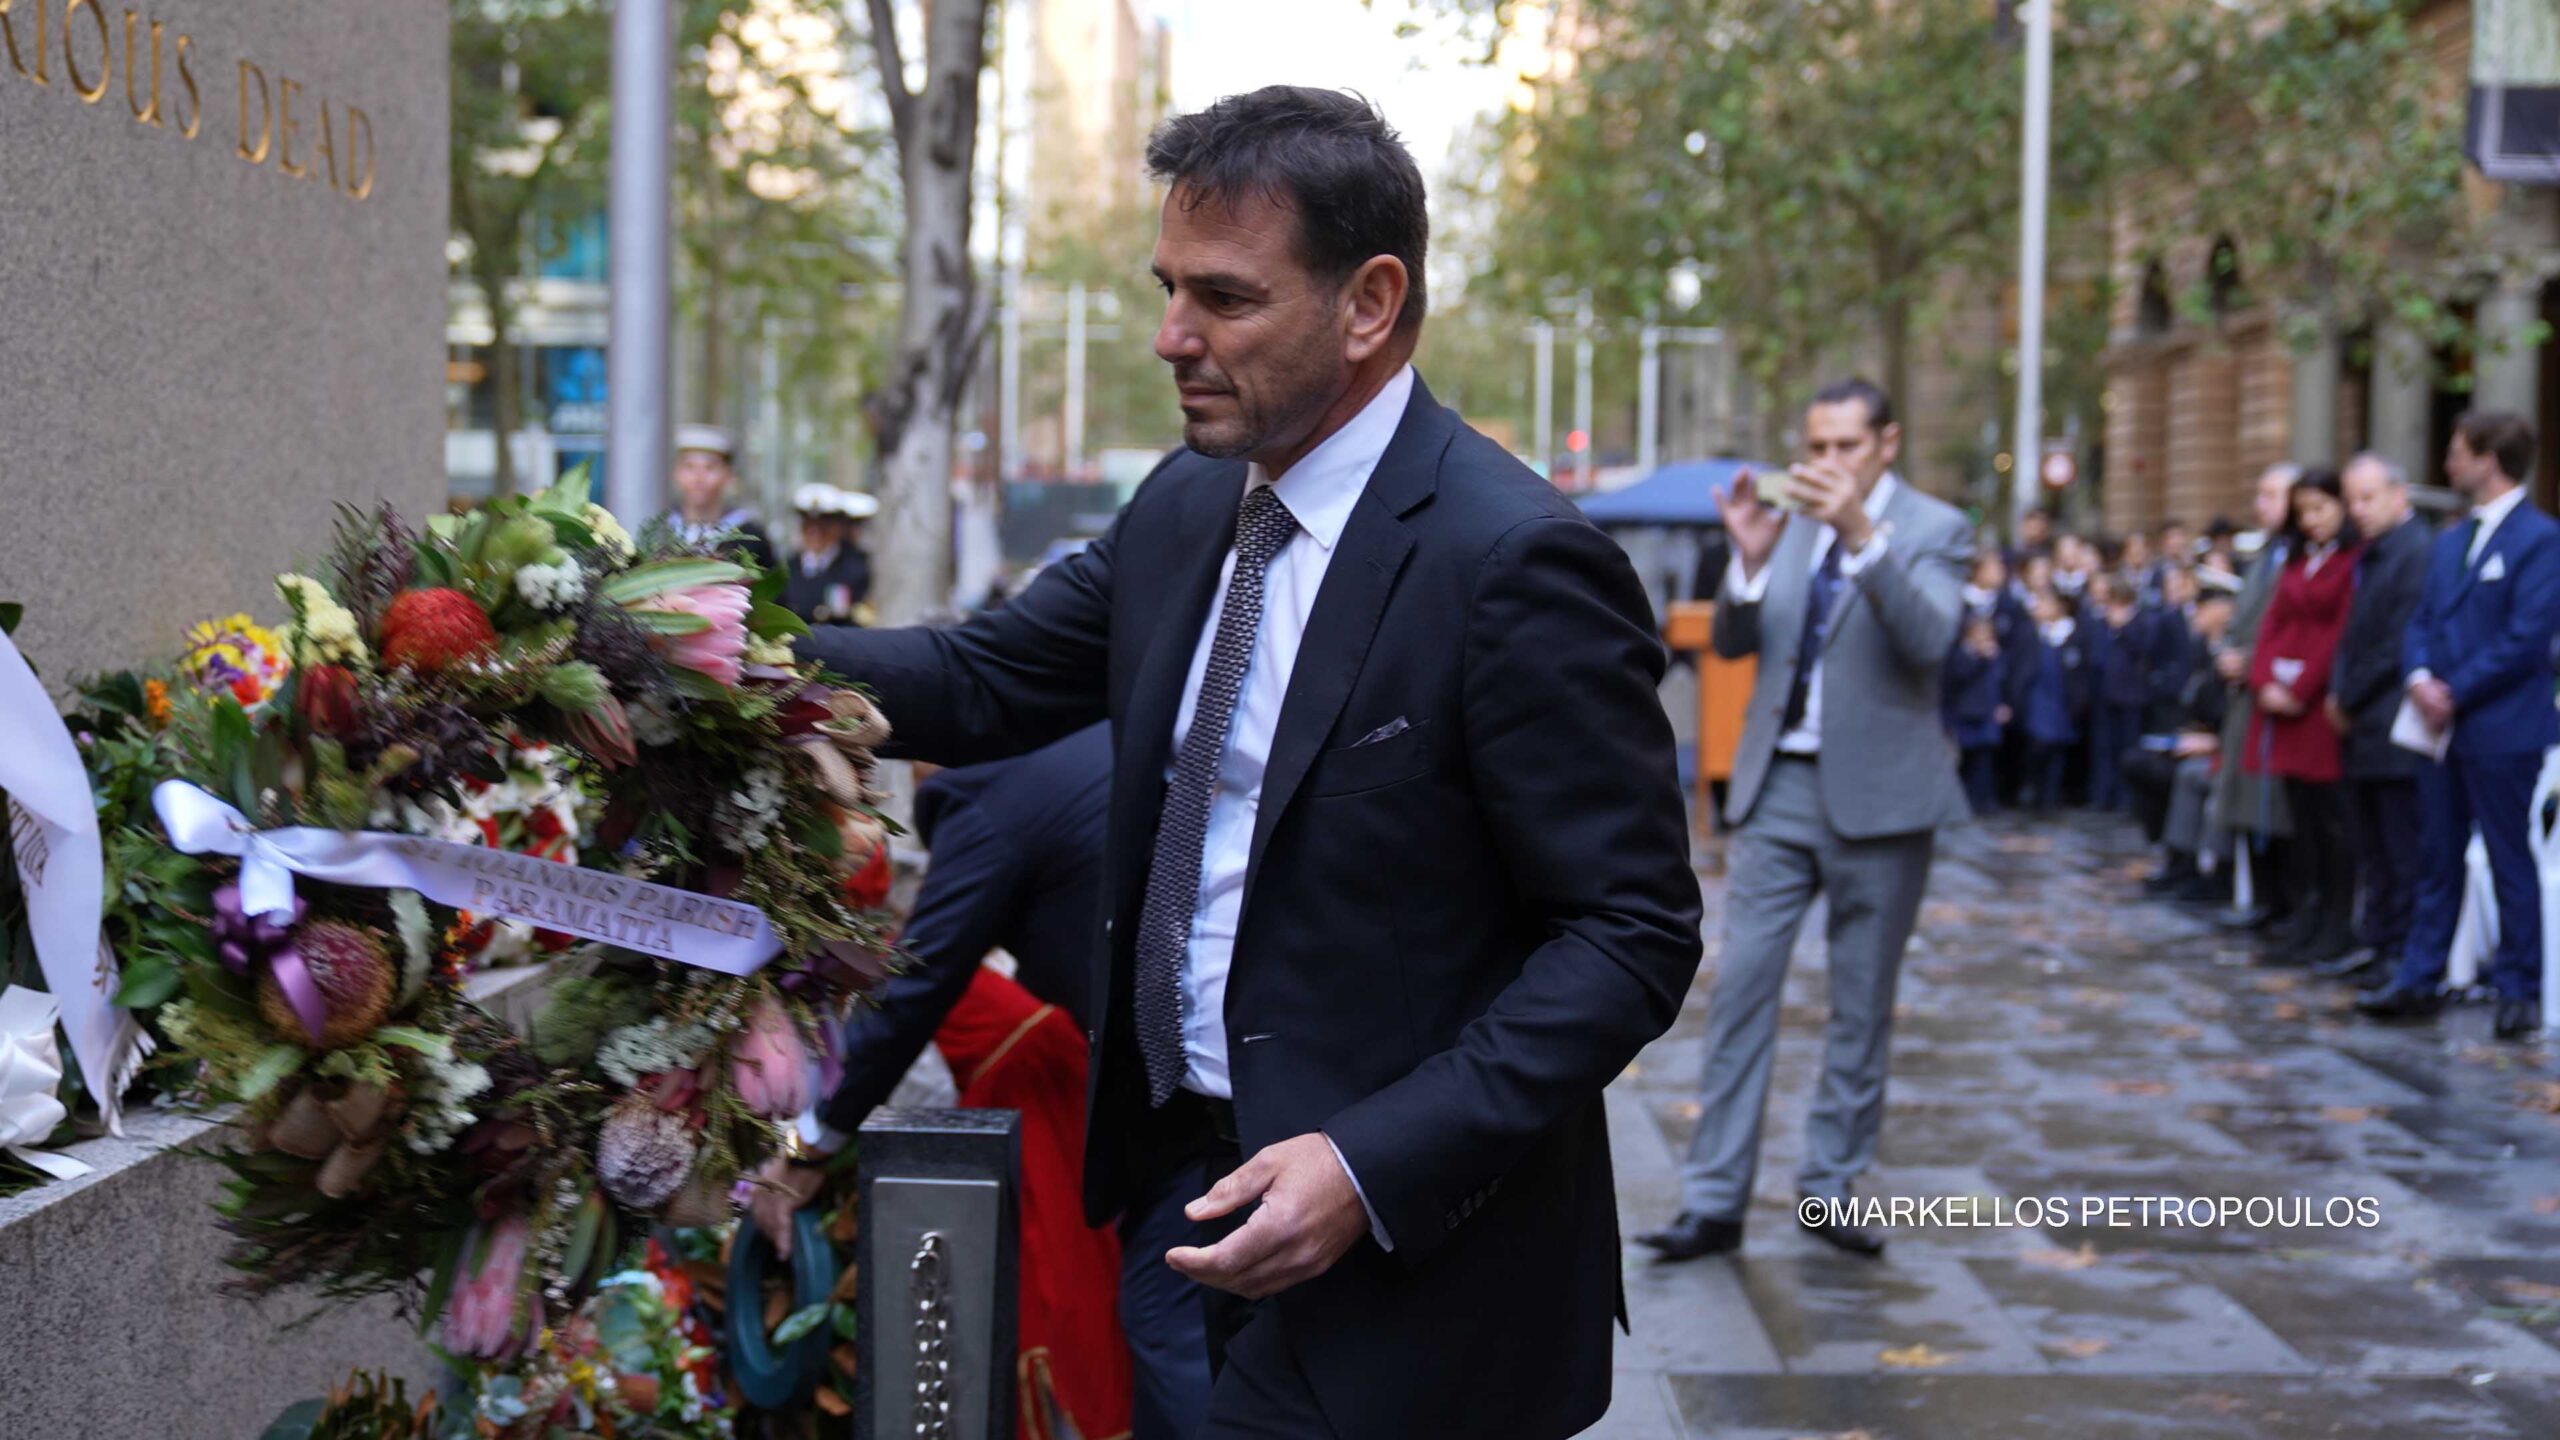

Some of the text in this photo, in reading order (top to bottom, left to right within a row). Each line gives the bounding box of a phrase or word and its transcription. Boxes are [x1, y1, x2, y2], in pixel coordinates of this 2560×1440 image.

[236, 59, 378, 200] DEAD
[457, 850, 626, 904] IOANNIS
[626, 885, 760, 941] PARISH
[472, 877, 675, 953] PARAMATTA
